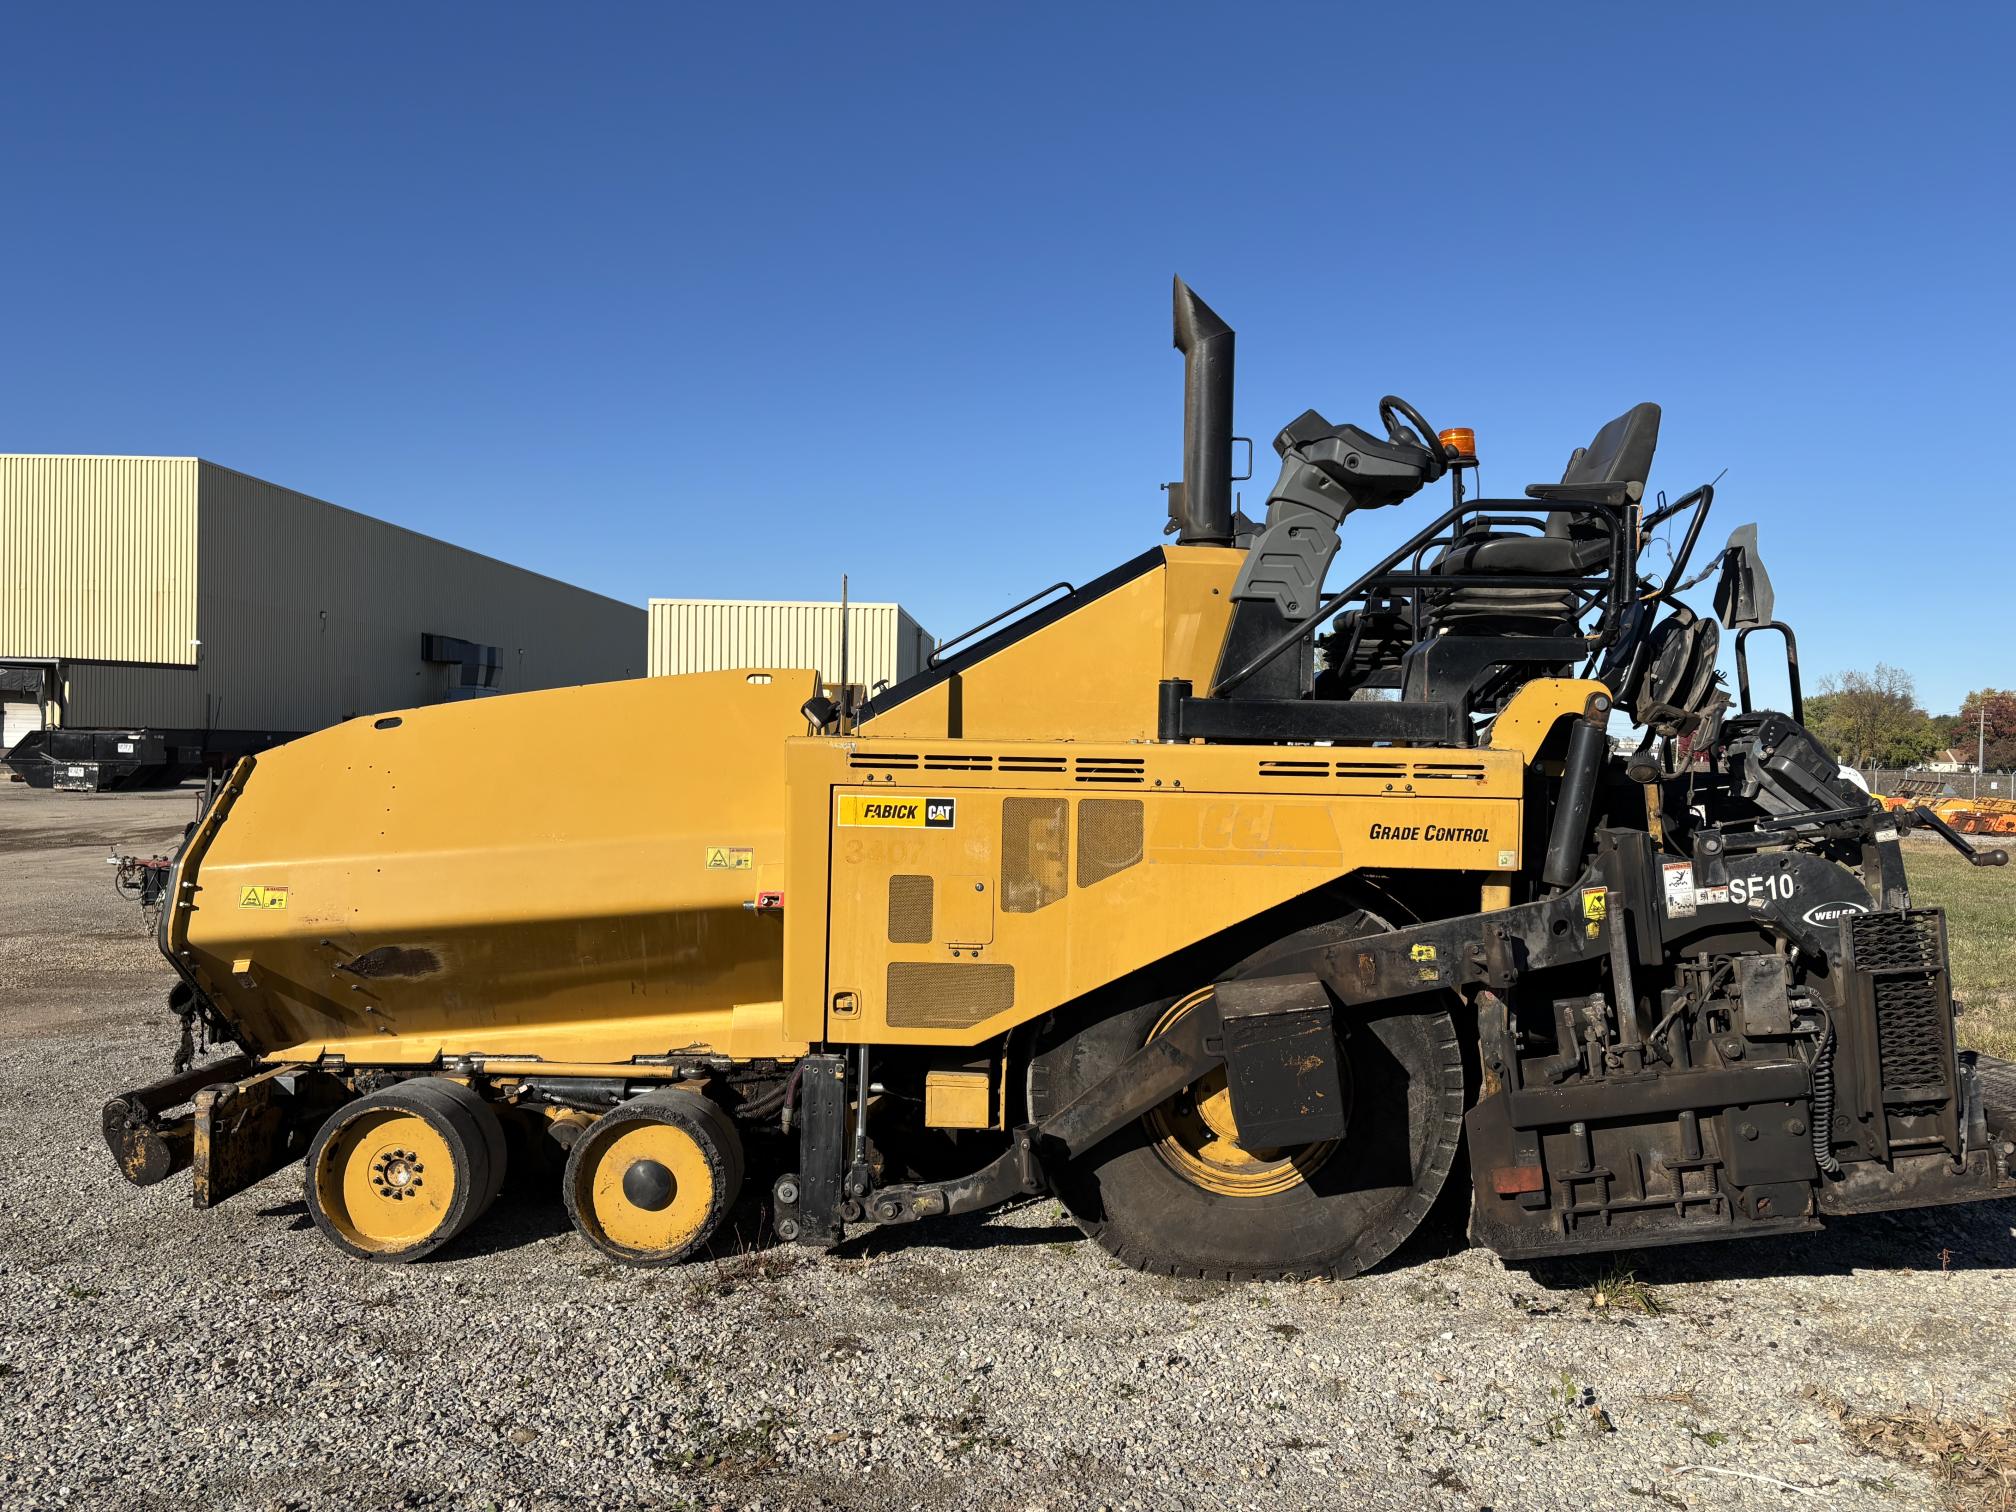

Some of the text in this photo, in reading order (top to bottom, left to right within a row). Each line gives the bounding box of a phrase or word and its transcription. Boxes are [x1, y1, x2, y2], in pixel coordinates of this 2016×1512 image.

[864, 804, 951, 820] FABICK CAT
[1730, 873, 1794, 904] SF10
